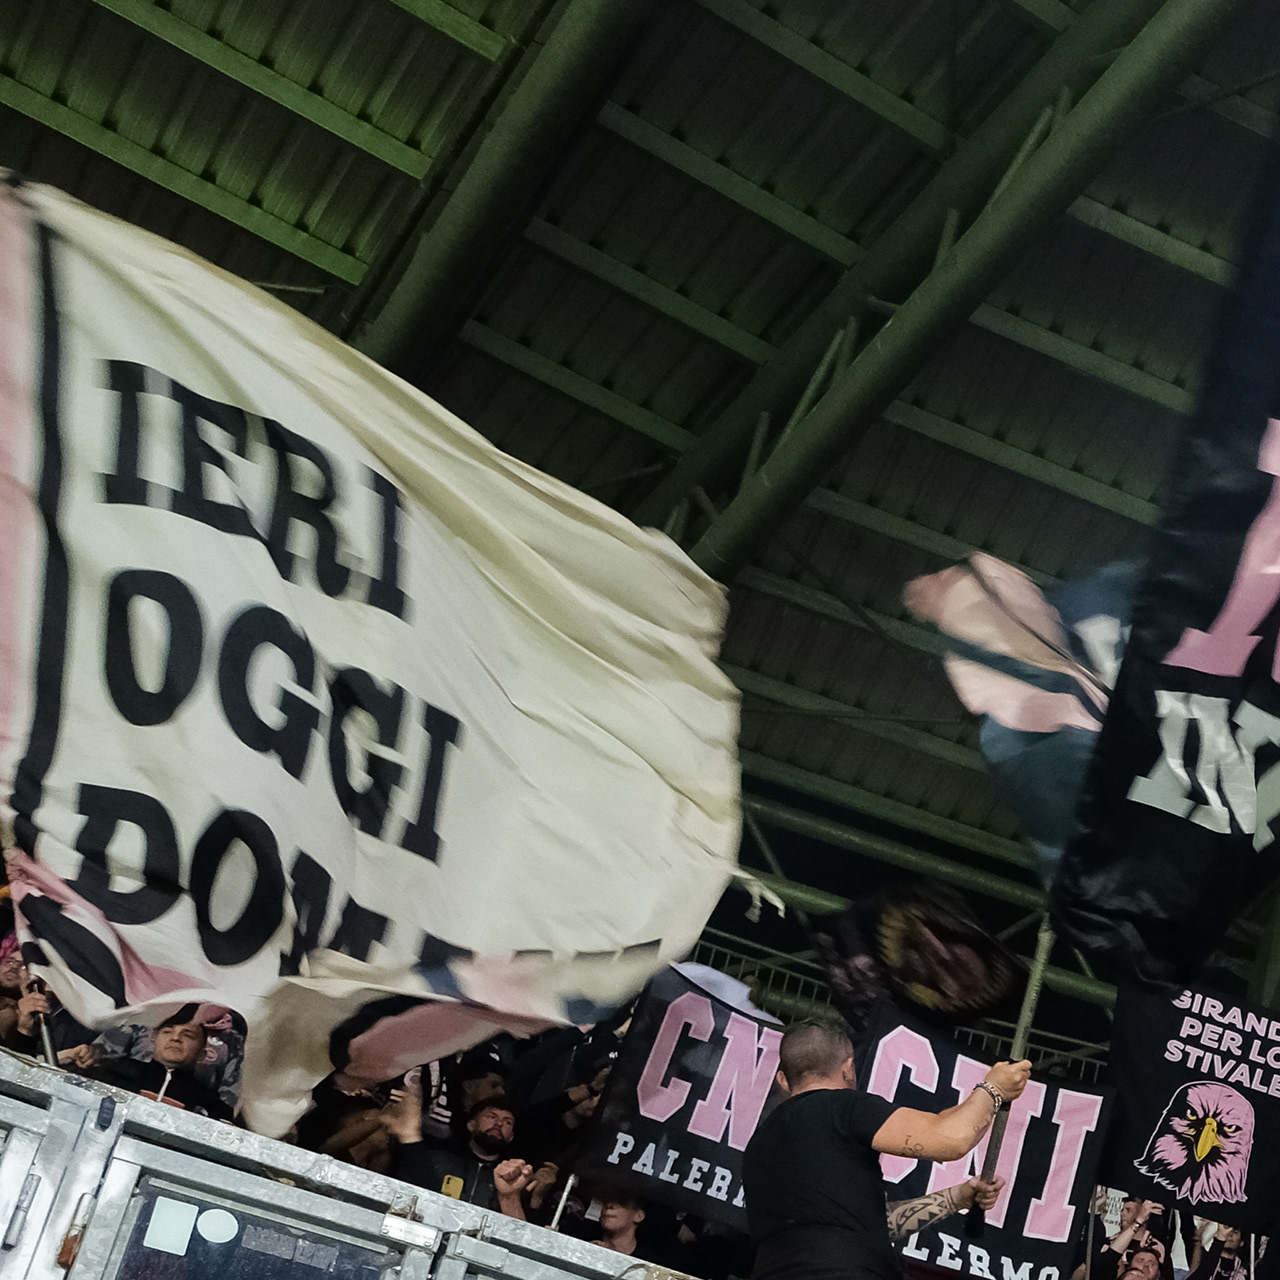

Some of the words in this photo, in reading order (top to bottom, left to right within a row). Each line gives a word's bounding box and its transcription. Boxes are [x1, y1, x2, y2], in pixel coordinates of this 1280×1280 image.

[97, 357, 415, 625] IERI
[104, 566, 465, 868] OGGI
[1179, 1015, 1243, 1056] PER
[607, 1132, 747, 1209] PALER
